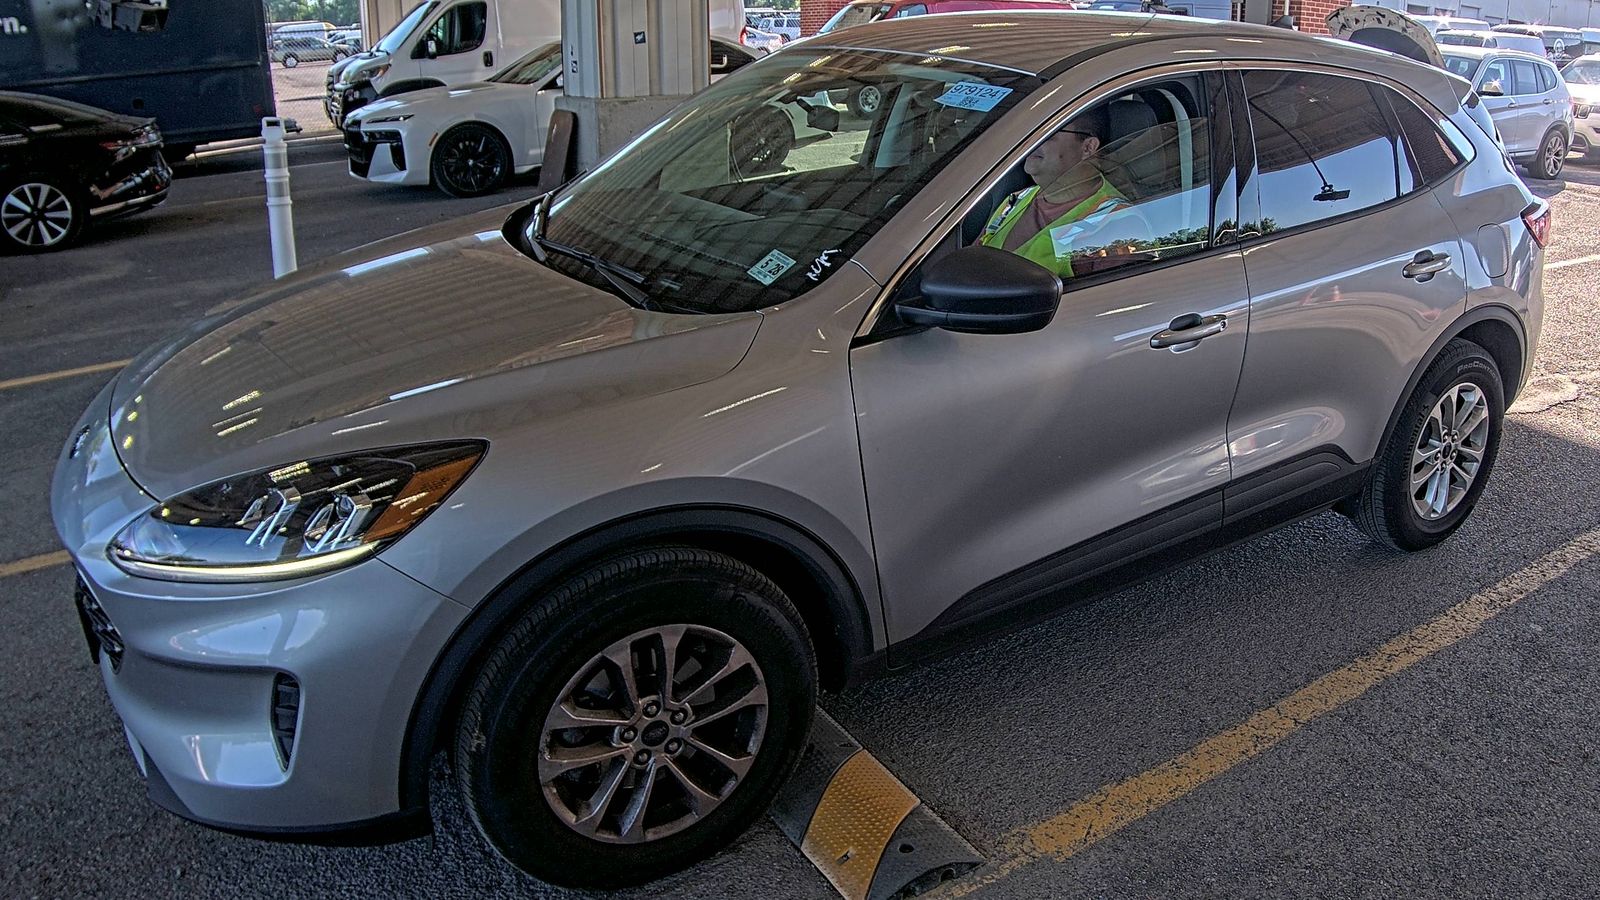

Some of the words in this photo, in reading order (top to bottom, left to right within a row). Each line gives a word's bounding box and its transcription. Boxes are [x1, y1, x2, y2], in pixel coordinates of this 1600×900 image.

[950, 84, 1007, 100] 9791241
[761, 259, 773, 269] 5
[767, 263, 785, 276] 28
